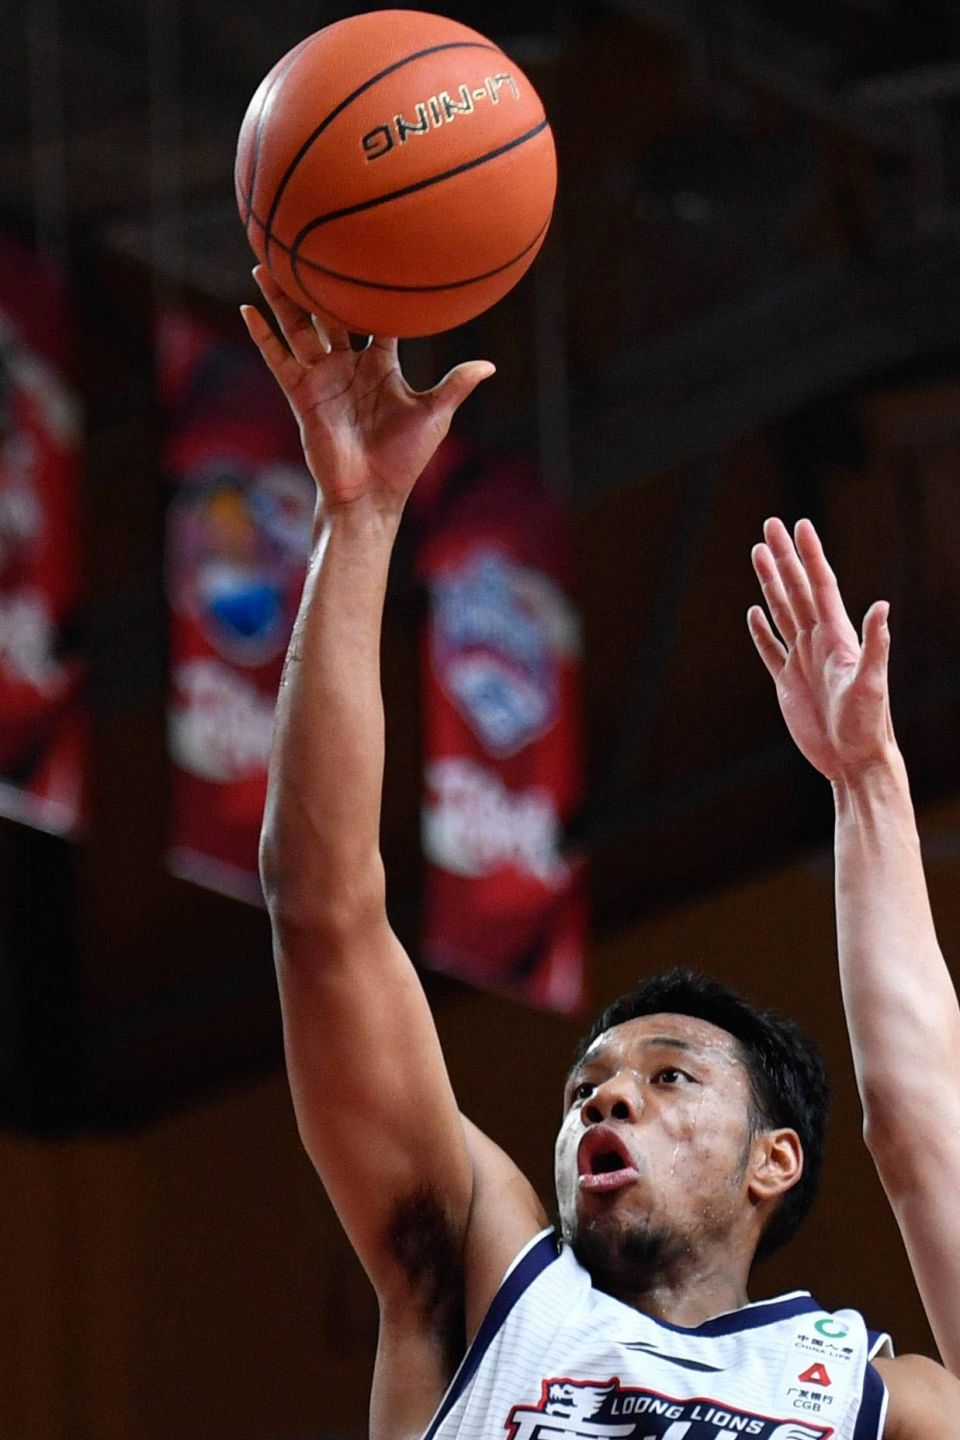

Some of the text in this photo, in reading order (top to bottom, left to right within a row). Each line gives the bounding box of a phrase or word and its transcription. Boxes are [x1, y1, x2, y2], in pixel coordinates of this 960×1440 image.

[361, 73, 520, 163] LI-NING
[795, 1342, 825, 1355] CHINA
[610, 1396, 766, 1435] LOONG LIONS
[793, 1399, 821, 1413] CGB
